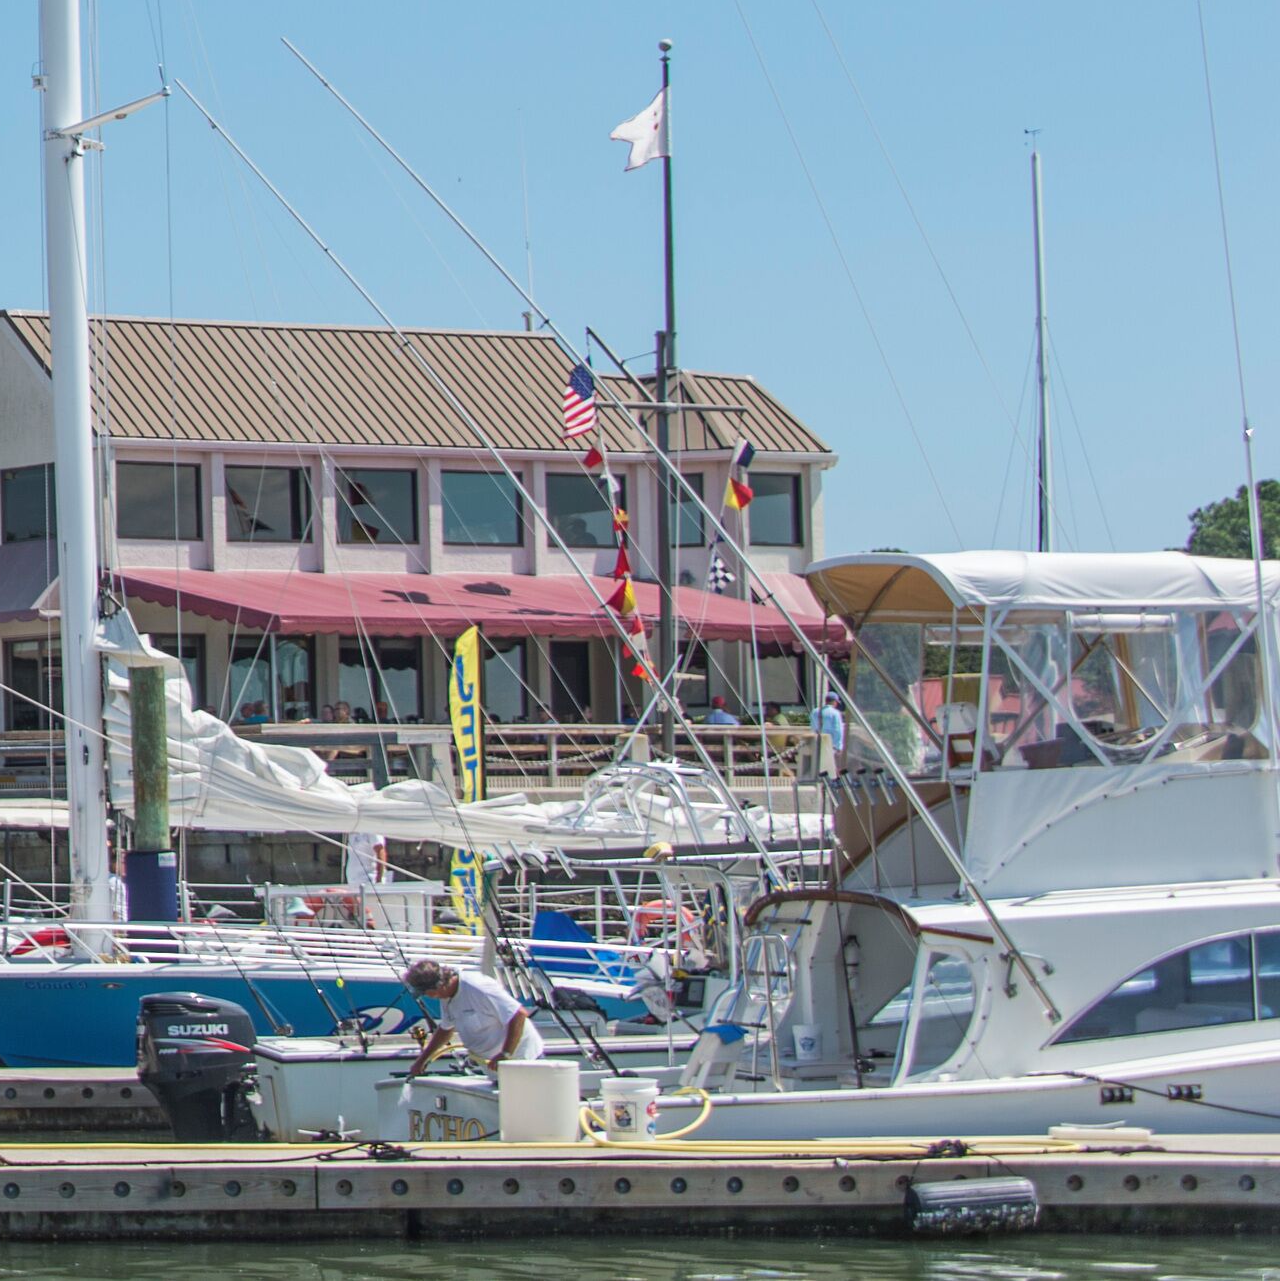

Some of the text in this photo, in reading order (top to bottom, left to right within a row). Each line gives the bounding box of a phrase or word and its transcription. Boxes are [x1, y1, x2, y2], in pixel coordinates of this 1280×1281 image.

[24, 980, 88, 990] Cloud 9
[167, 1023, 229, 1036] SUZUKI
[408, 1109, 488, 1142] ECHO
